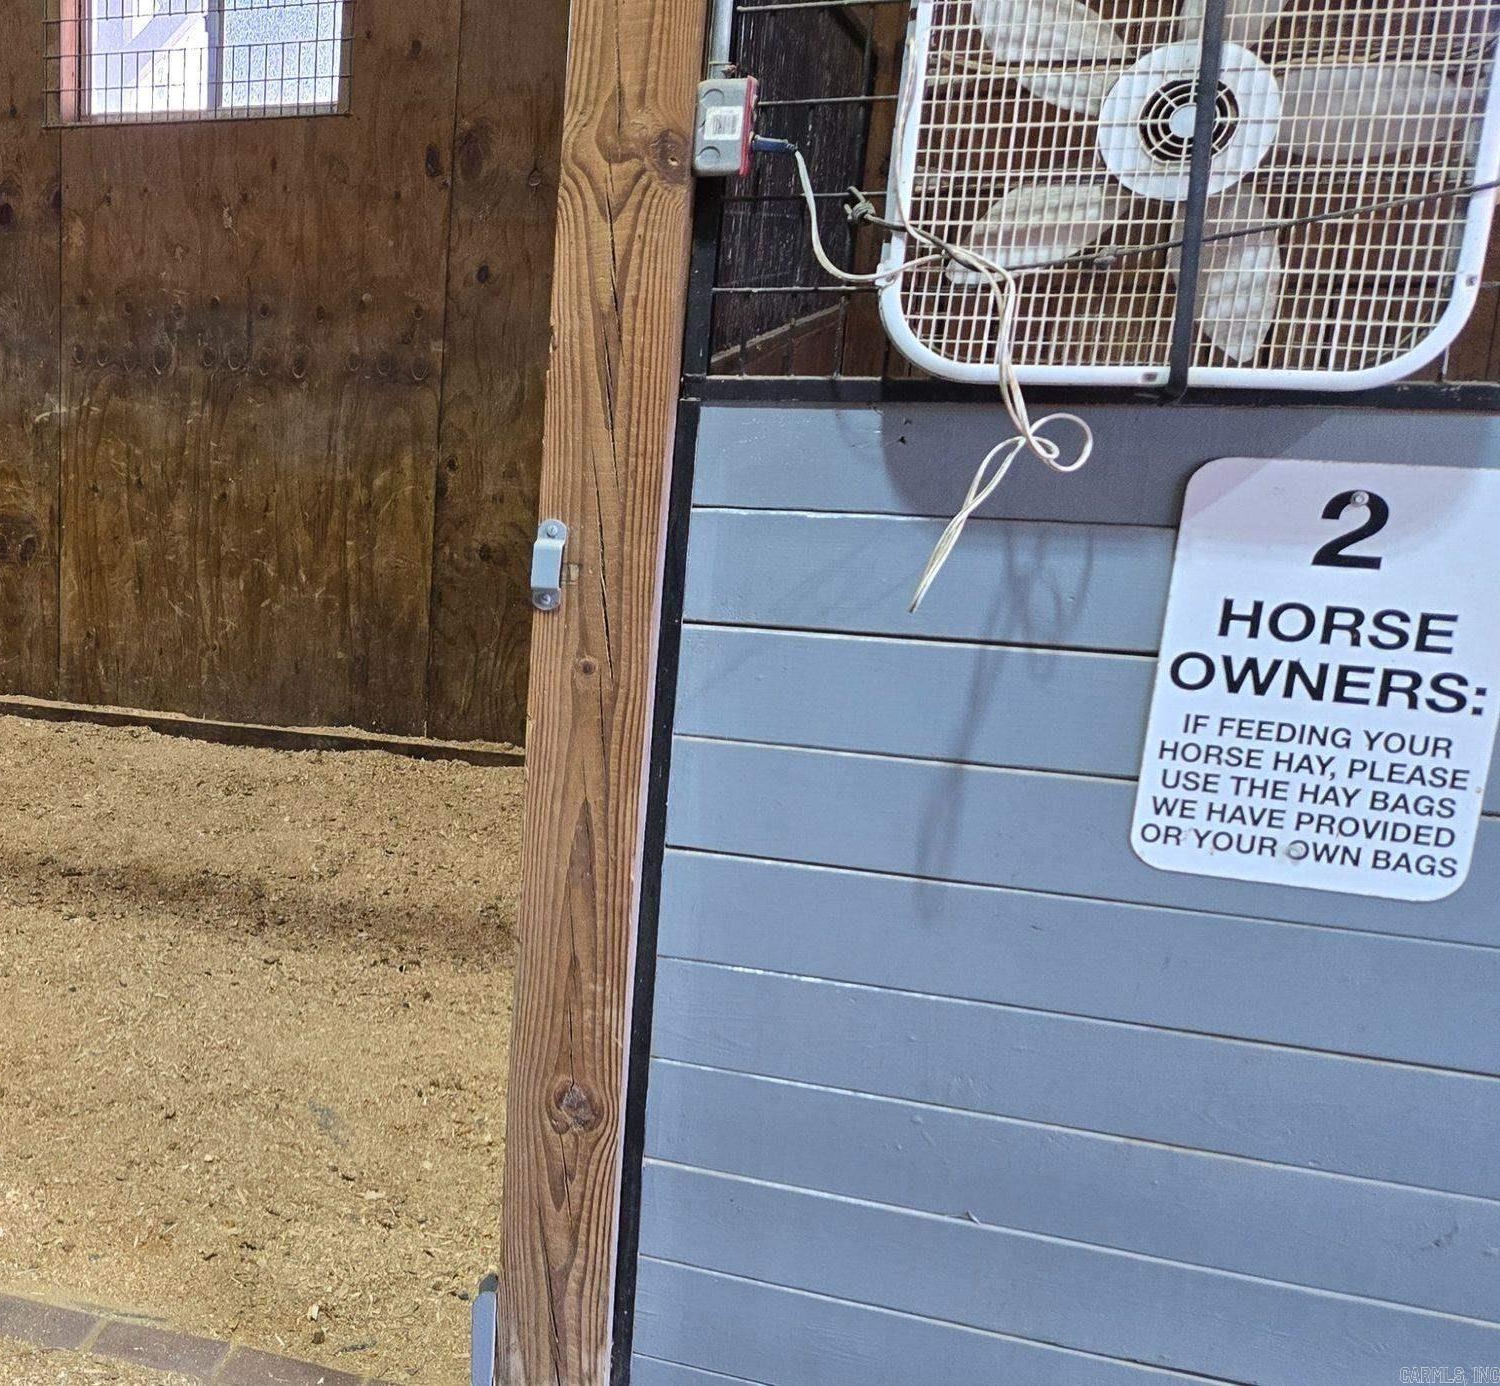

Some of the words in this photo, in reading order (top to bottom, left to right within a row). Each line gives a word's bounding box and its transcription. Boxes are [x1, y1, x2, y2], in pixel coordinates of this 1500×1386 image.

[1311, 489, 1390, 571] 2
[1217, 598, 1459, 655] HORSE
[1169, 651, 1487, 717] OWNERS:
[1182, 713, 1210, 735] IF
[1218, 716, 1351, 749] FEEDING
[1363, 729, 1453, 759] YOUR
[1158, 740, 1262, 770] HORSE
[1272, 751, 1336, 780] HAY,
[1347, 759, 1470, 791] PLEASE
[1161, 768, 1219, 793] USE
[1230, 775, 1288, 801] THE
[1299, 782, 1361, 808] HAY
[1369, 790, 1456, 819] BAGS
[1152, 796, 1196, 819] WE
[1206, 801, 1285, 829] HAVE
[1294, 811, 1455, 849] PROVIDED
[1140, 823, 1181, 846] OR
[1192, 828, 1277, 857] YOUR
[1285, 838, 1362, 868] OWN
[1371, 848, 1458, 878] BAGS
